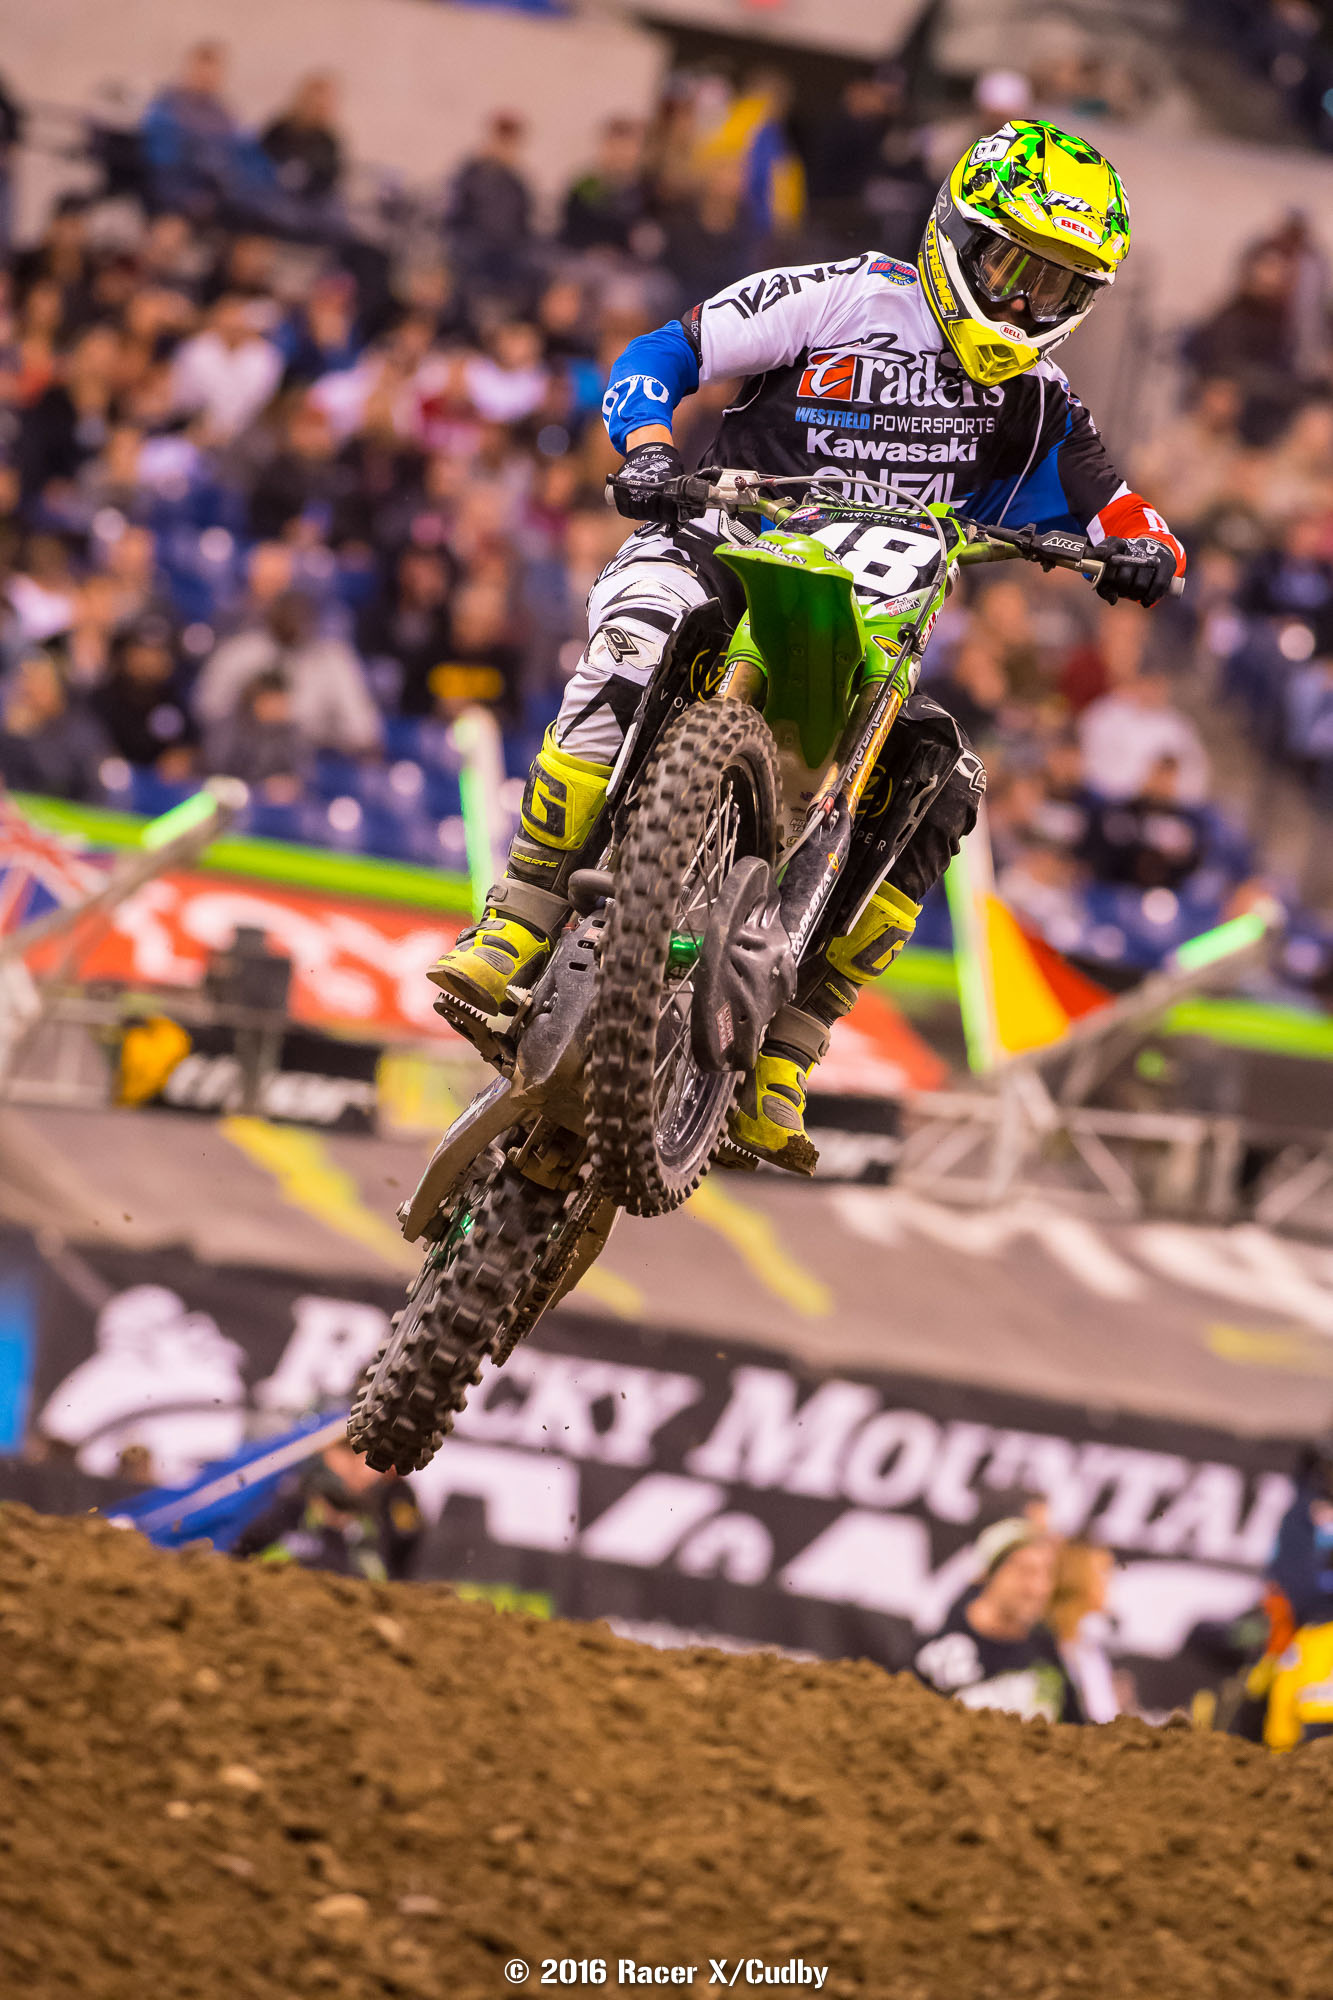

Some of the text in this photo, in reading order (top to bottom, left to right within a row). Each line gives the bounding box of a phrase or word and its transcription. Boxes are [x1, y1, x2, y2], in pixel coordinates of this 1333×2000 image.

[1060, 218, 1096, 241] BELL
[926, 218, 957, 311] XTREME
[1002, 326, 1021, 340] BELL
[795, 407, 996, 434] WESTFIELD POWERSPORTS
[651, 453, 673, 463] MOTO
[807, 428, 980, 463] Kawasaki
[1042, 537, 1085, 552] ARC
[255, 1296, 702, 1467] RCKY
[685, 1365, 1294, 1566] MOUNTAI
